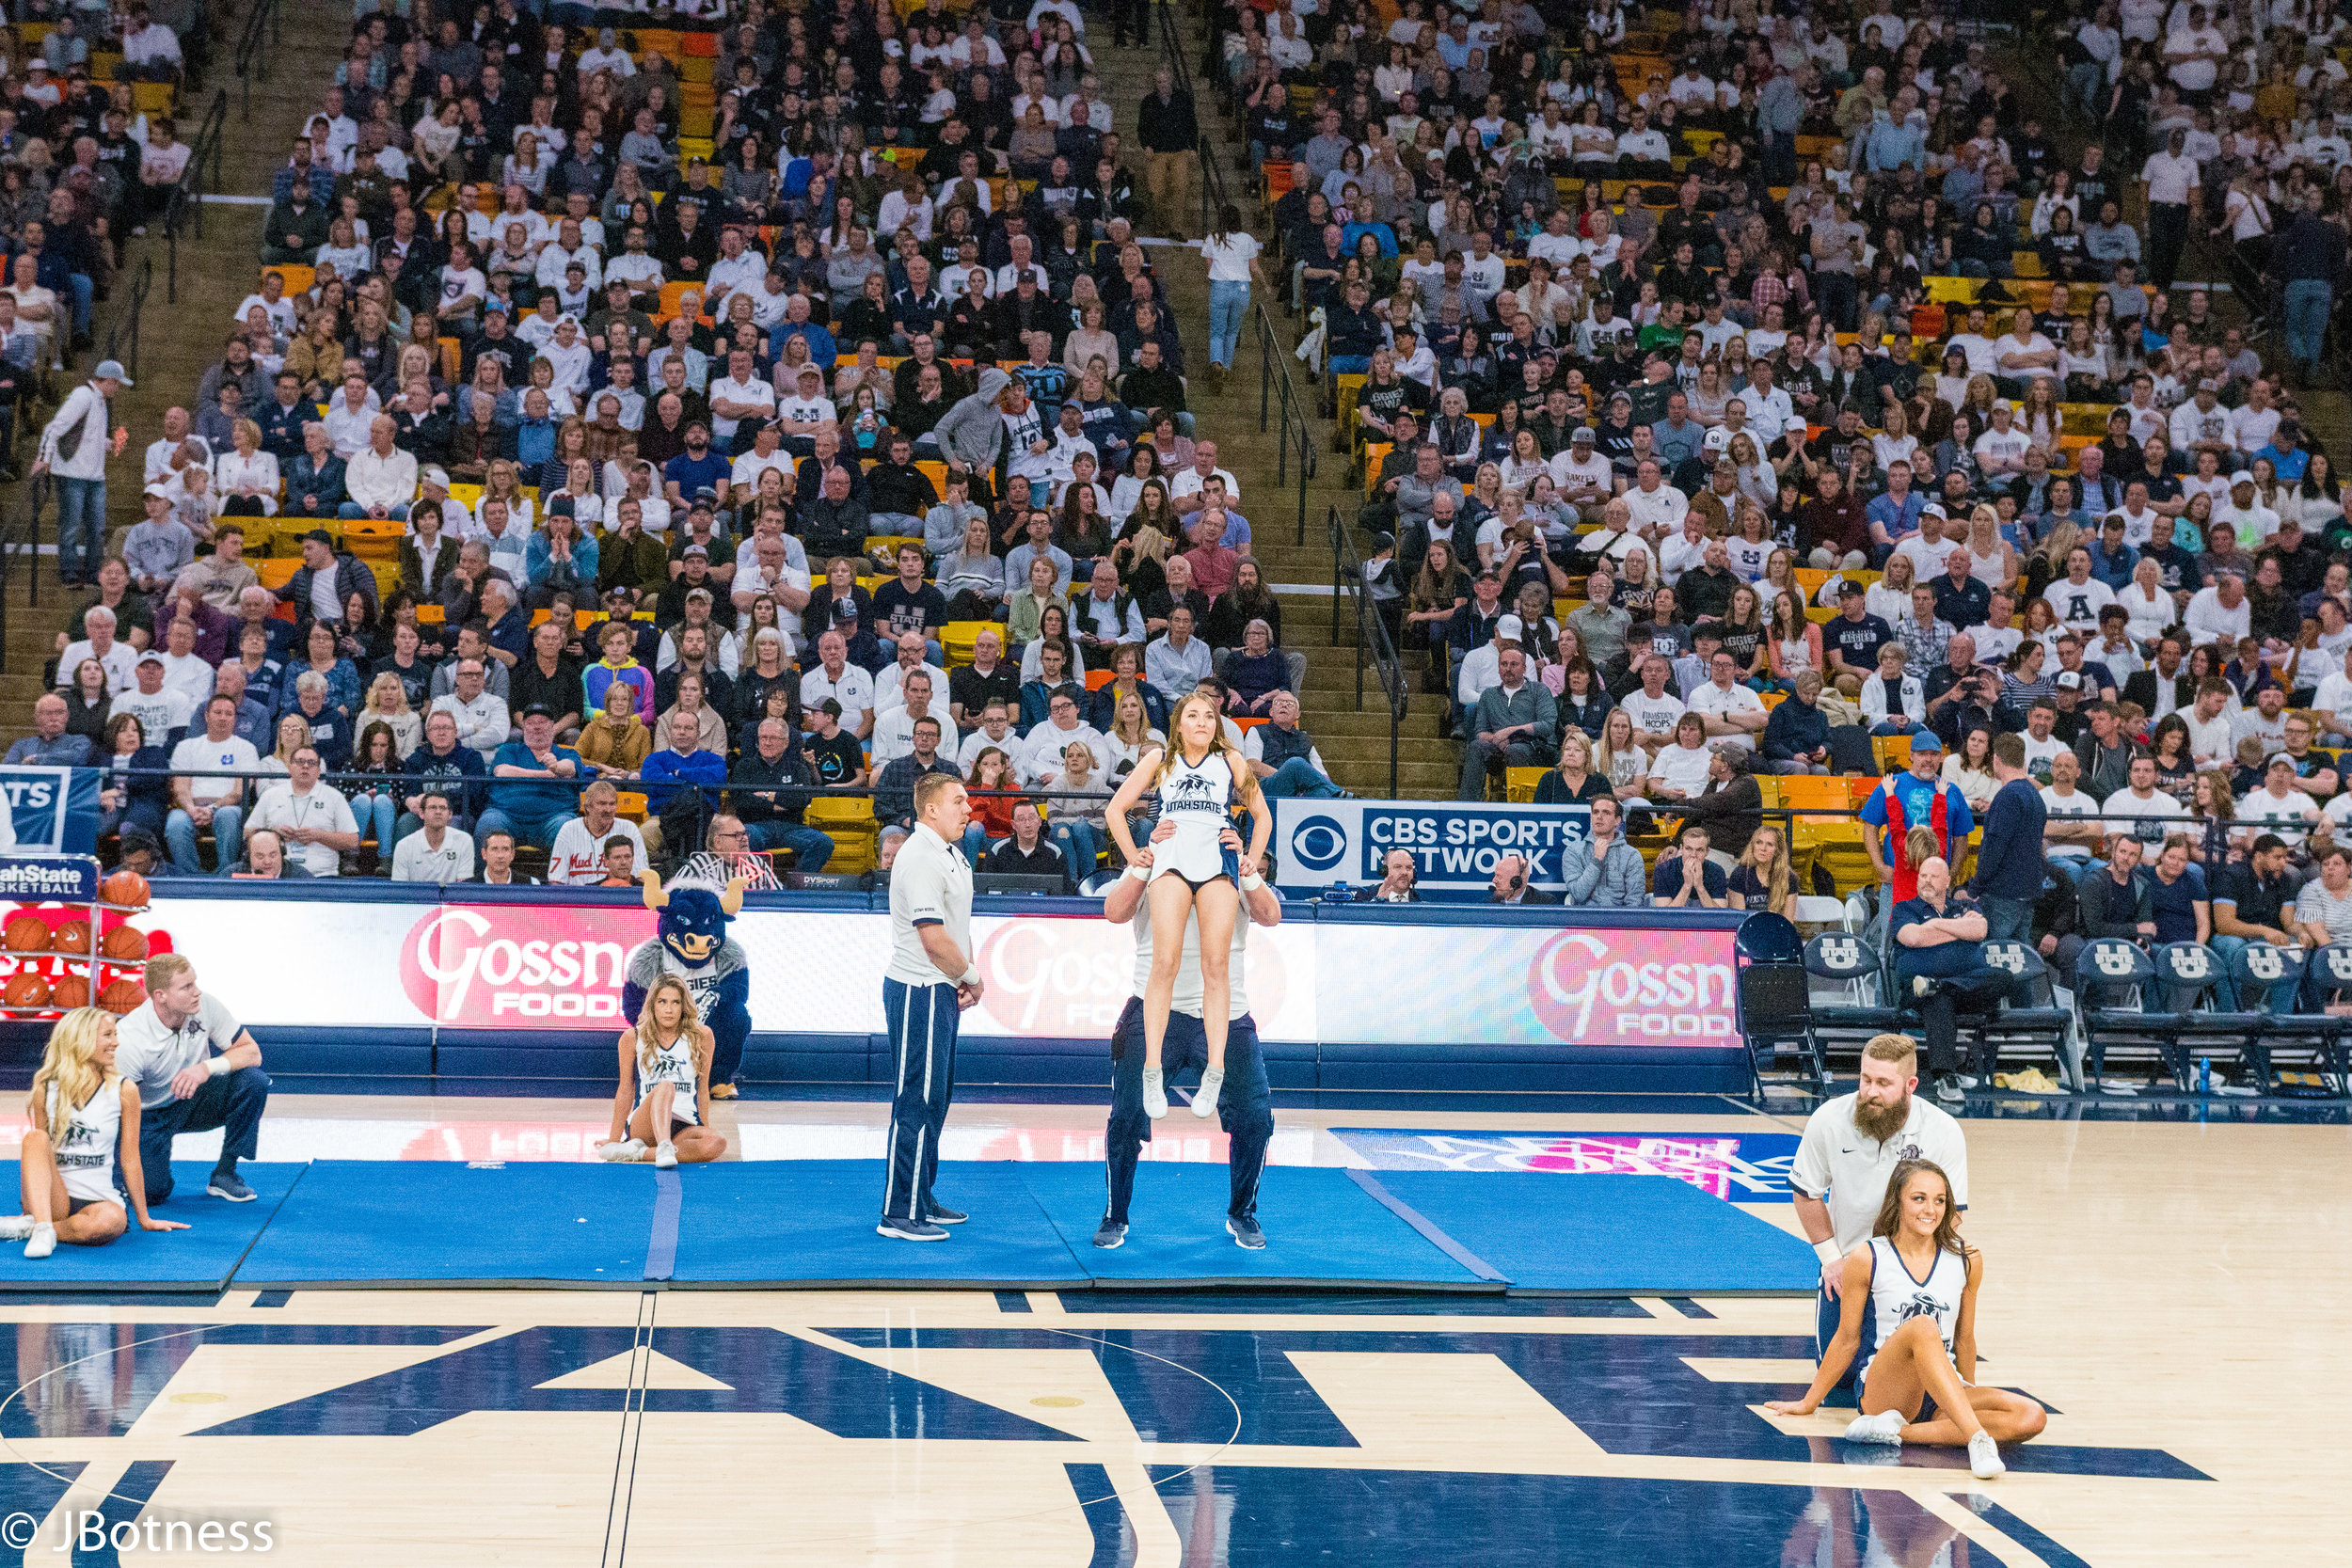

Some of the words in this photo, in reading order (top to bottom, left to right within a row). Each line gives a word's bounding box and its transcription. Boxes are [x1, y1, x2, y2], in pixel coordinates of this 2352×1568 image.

[2065, 594, 2095, 622] A
[890, 614, 925, 627] STATE
[1645, 719, 1671, 728] HOOPS
[1166, 800, 1192, 814] UTAH
[1193, 800, 1222, 815] STATE
[1370, 816, 1438, 844] CBS
[1445, 817, 1582, 847] SPORTS
[549, 857, 562, 873] 7
[1370, 846, 1549, 876] NTWOK
[687, 975, 718, 990] GIES
[1542, 933, 1736, 1039] Gossn
[493, 992, 625, 1017] FOOD
[1616, 1013, 1740, 1037] FOOD
